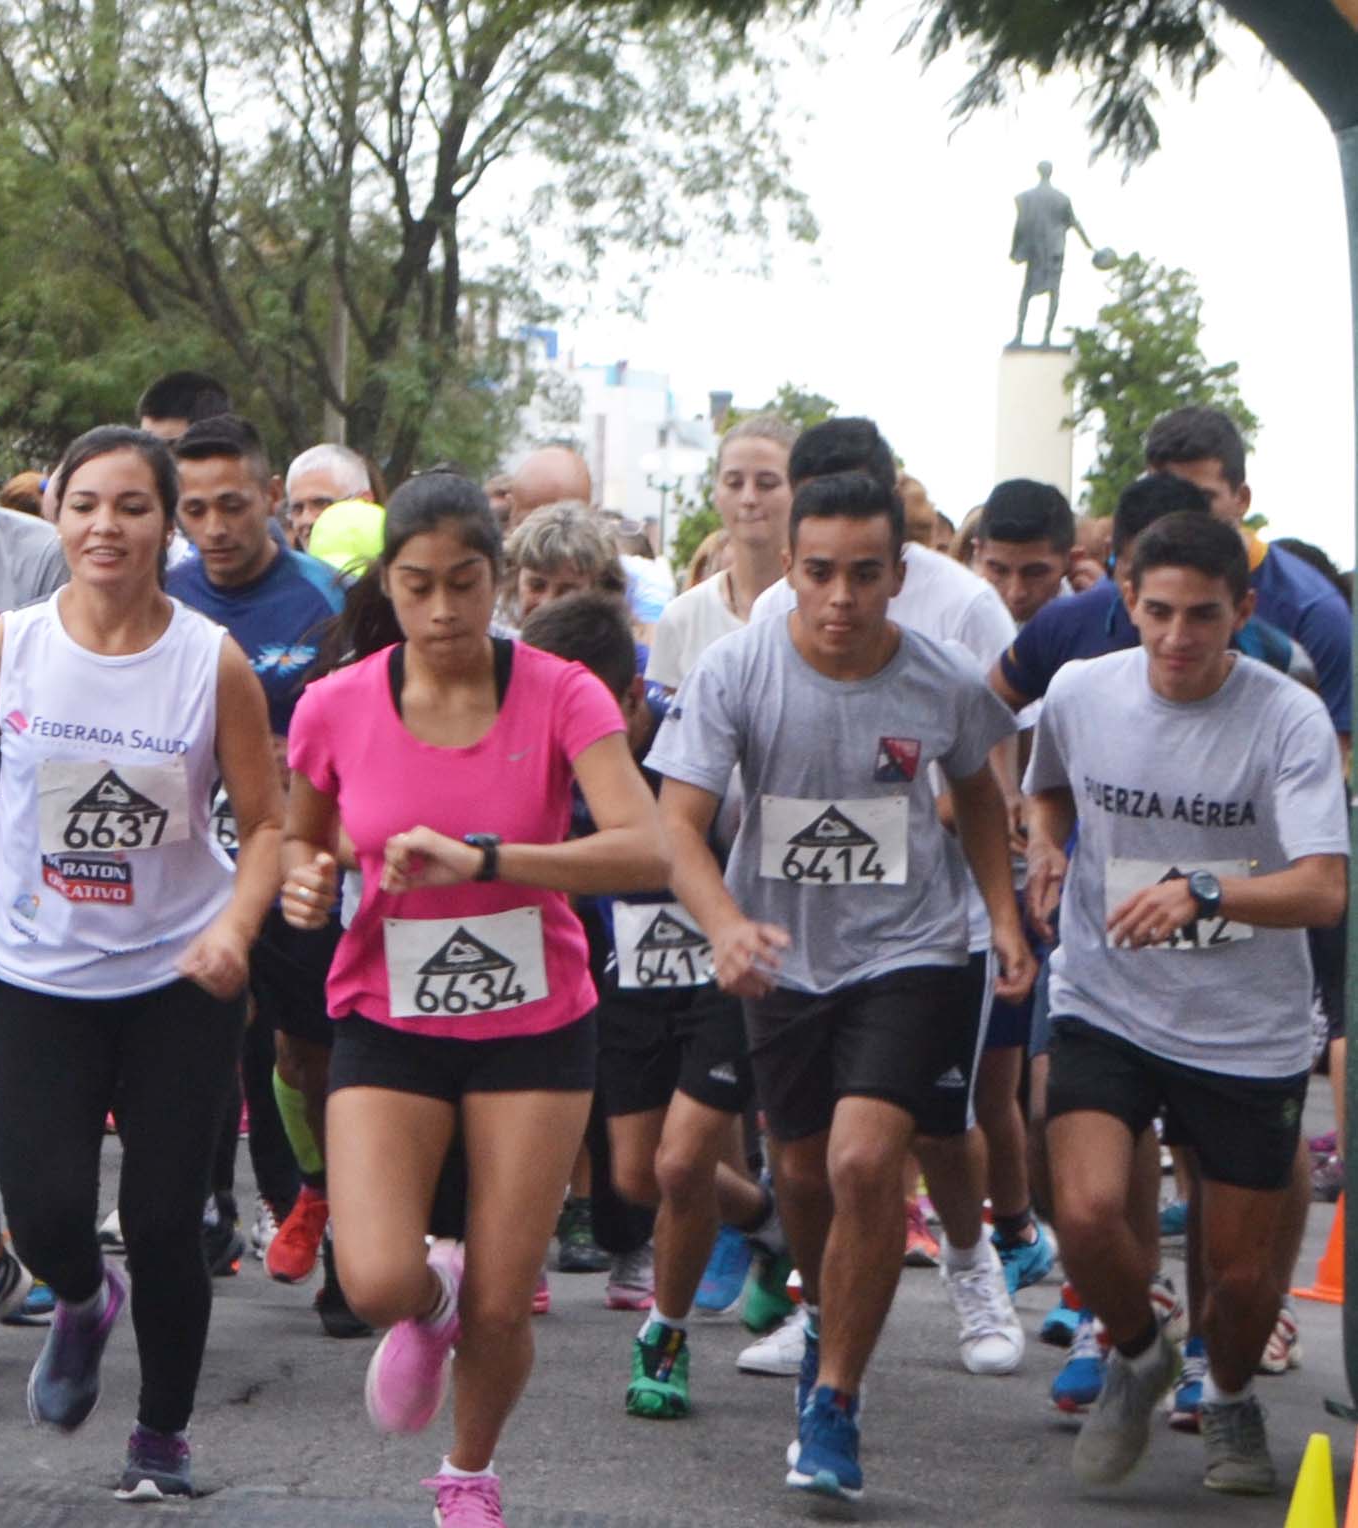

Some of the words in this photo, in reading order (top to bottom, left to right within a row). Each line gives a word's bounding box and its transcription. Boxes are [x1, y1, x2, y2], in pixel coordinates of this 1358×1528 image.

[31, 715, 124, 746] FEDERADA
[1172, 793, 1256, 827] AÉREA
[63, 808, 170, 850] 6637
[781, 846, 886, 883] 6414
[414, 964, 526, 1014] 6634
